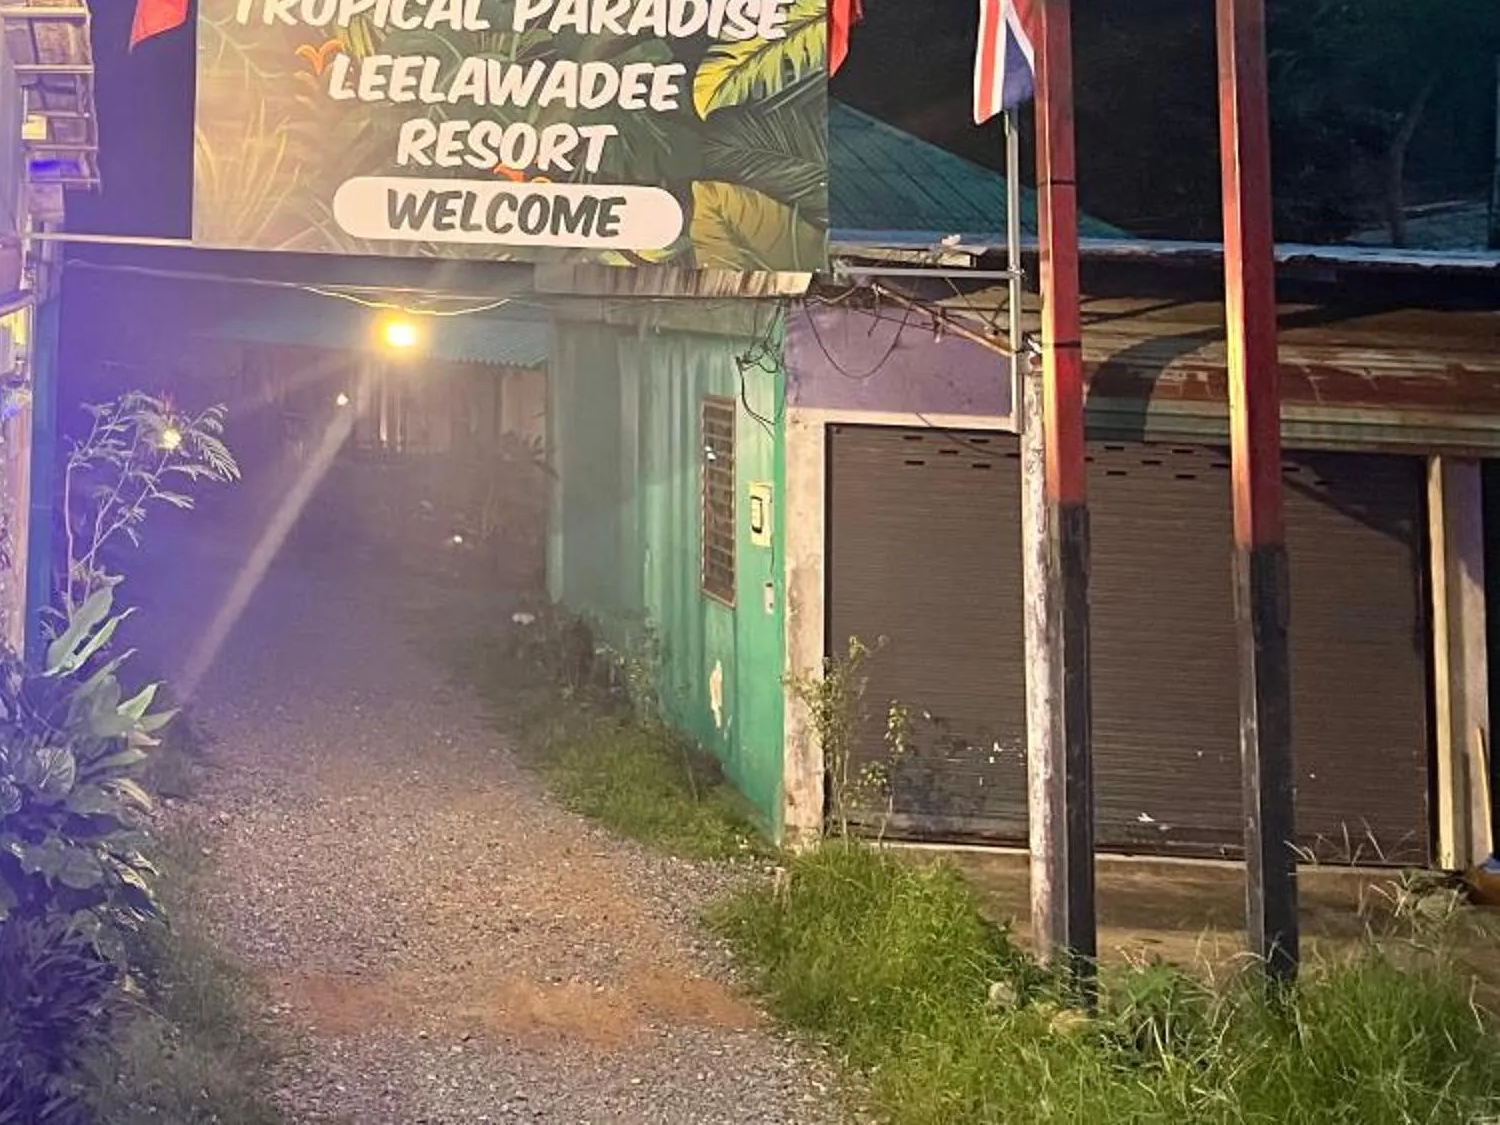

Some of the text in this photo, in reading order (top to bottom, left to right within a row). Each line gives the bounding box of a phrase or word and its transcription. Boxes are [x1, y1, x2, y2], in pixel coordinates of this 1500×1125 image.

[328, 53, 687, 112] LEELAWADEE
[396, 118, 618, 174] RESORT
[385, 187, 627, 238] WELCOME
